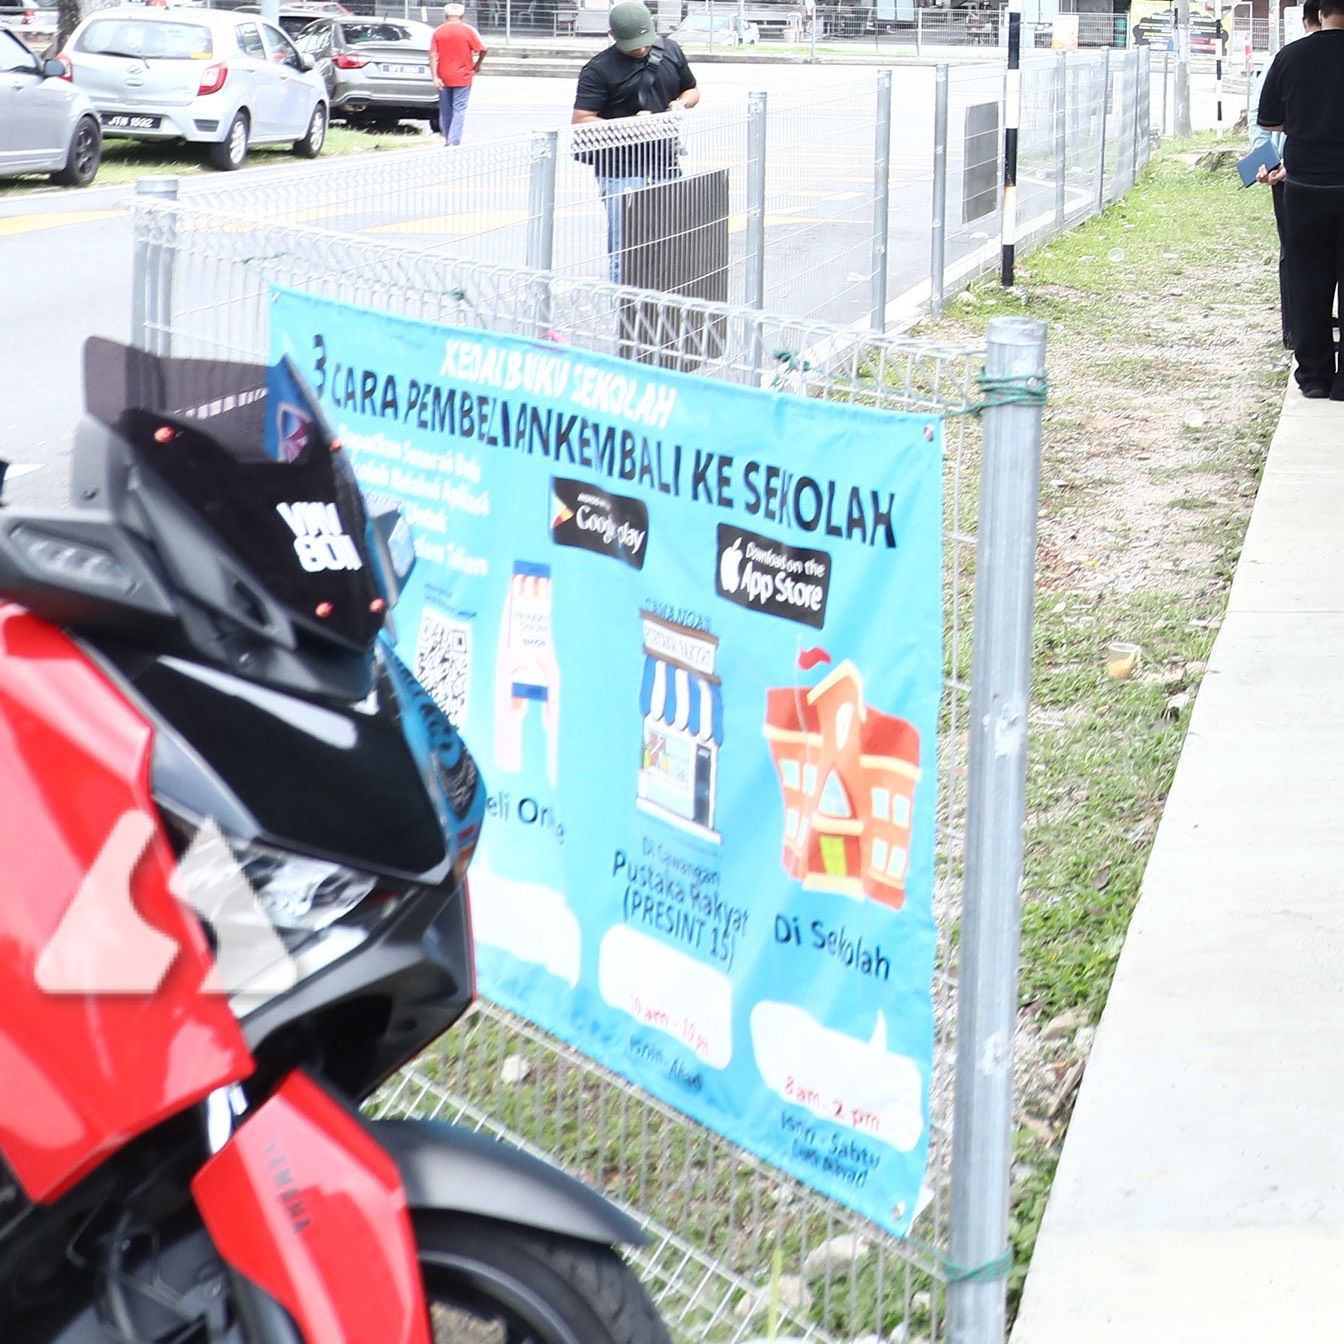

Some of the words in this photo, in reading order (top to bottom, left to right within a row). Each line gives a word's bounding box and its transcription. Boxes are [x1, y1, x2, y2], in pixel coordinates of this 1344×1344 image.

[572, 364, 678, 429] SEKOLAH
[312, 333, 327, 398] 3
[331, 362, 399, 421] CARA
[692, 449, 735, 509] KE
[743, 460, 897, 548] SEKOLAH
[740, 561, 774, 605] App
[774, 571, 823, 611] Store
[746, 541, 787, 570] Download
[786, 559, 803, 574] on
[804, 558, 826, 578] the
[486, 791, 510, 821] eli
[612, 849, 685, 905] Pustaka
[690, 884, 750, 940] Rakyat
[623, 885, 706, 949] (PRESINT
[710, 926, 735, 974] 15)
[774, 912, 801, 946] Di
[810, 919, 890, 982] Sekolah
[832, 1098, 845, 1121] 2
[850, 1107, 881, 1134] pm
[264, 1141, 312, 1234] YAMAHA
